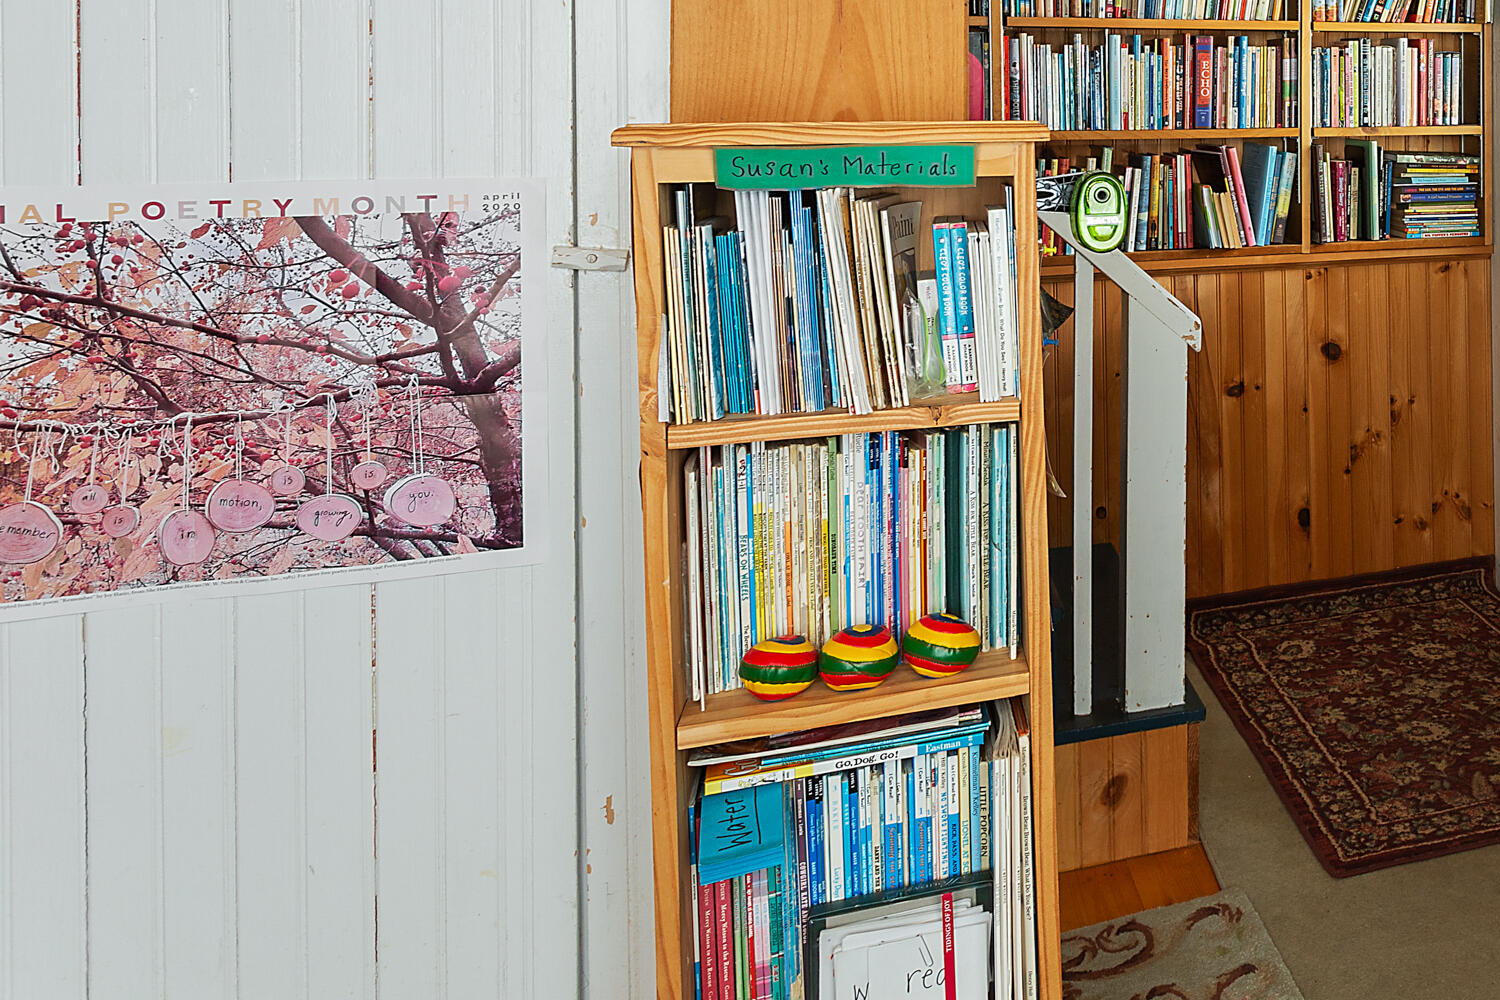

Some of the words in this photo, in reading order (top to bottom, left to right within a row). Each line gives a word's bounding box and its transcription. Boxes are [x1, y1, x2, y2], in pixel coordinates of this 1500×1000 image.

[1200, 61, 1209, 97] ECHO
[731, 155, 829, 178] Susan's
[842, 150, 957, 178] Materials
[108, 198, 293, 222] POETRY
[313, 193, 470, 216] MONTH
[482, 192, 521, 203] april
[482, 202, 521, 213] 2020
[219, 495, 262, 512] motion,
[407, 490, 434, 514] you.
[314, 509, 353, 527] growing,
[179, 529, 196, 540] in
[879, 750, 899, 761] Go!
[925, 740, 961, 752] Eastman
[979, 786, 987, 812] LITTLE
[716, 798, 753, 852] Water
[980, 815, 988, 857] POPCORN
[944, 900, 952, 912] JOY
[945, 923, 953, 953] TIDINGS
